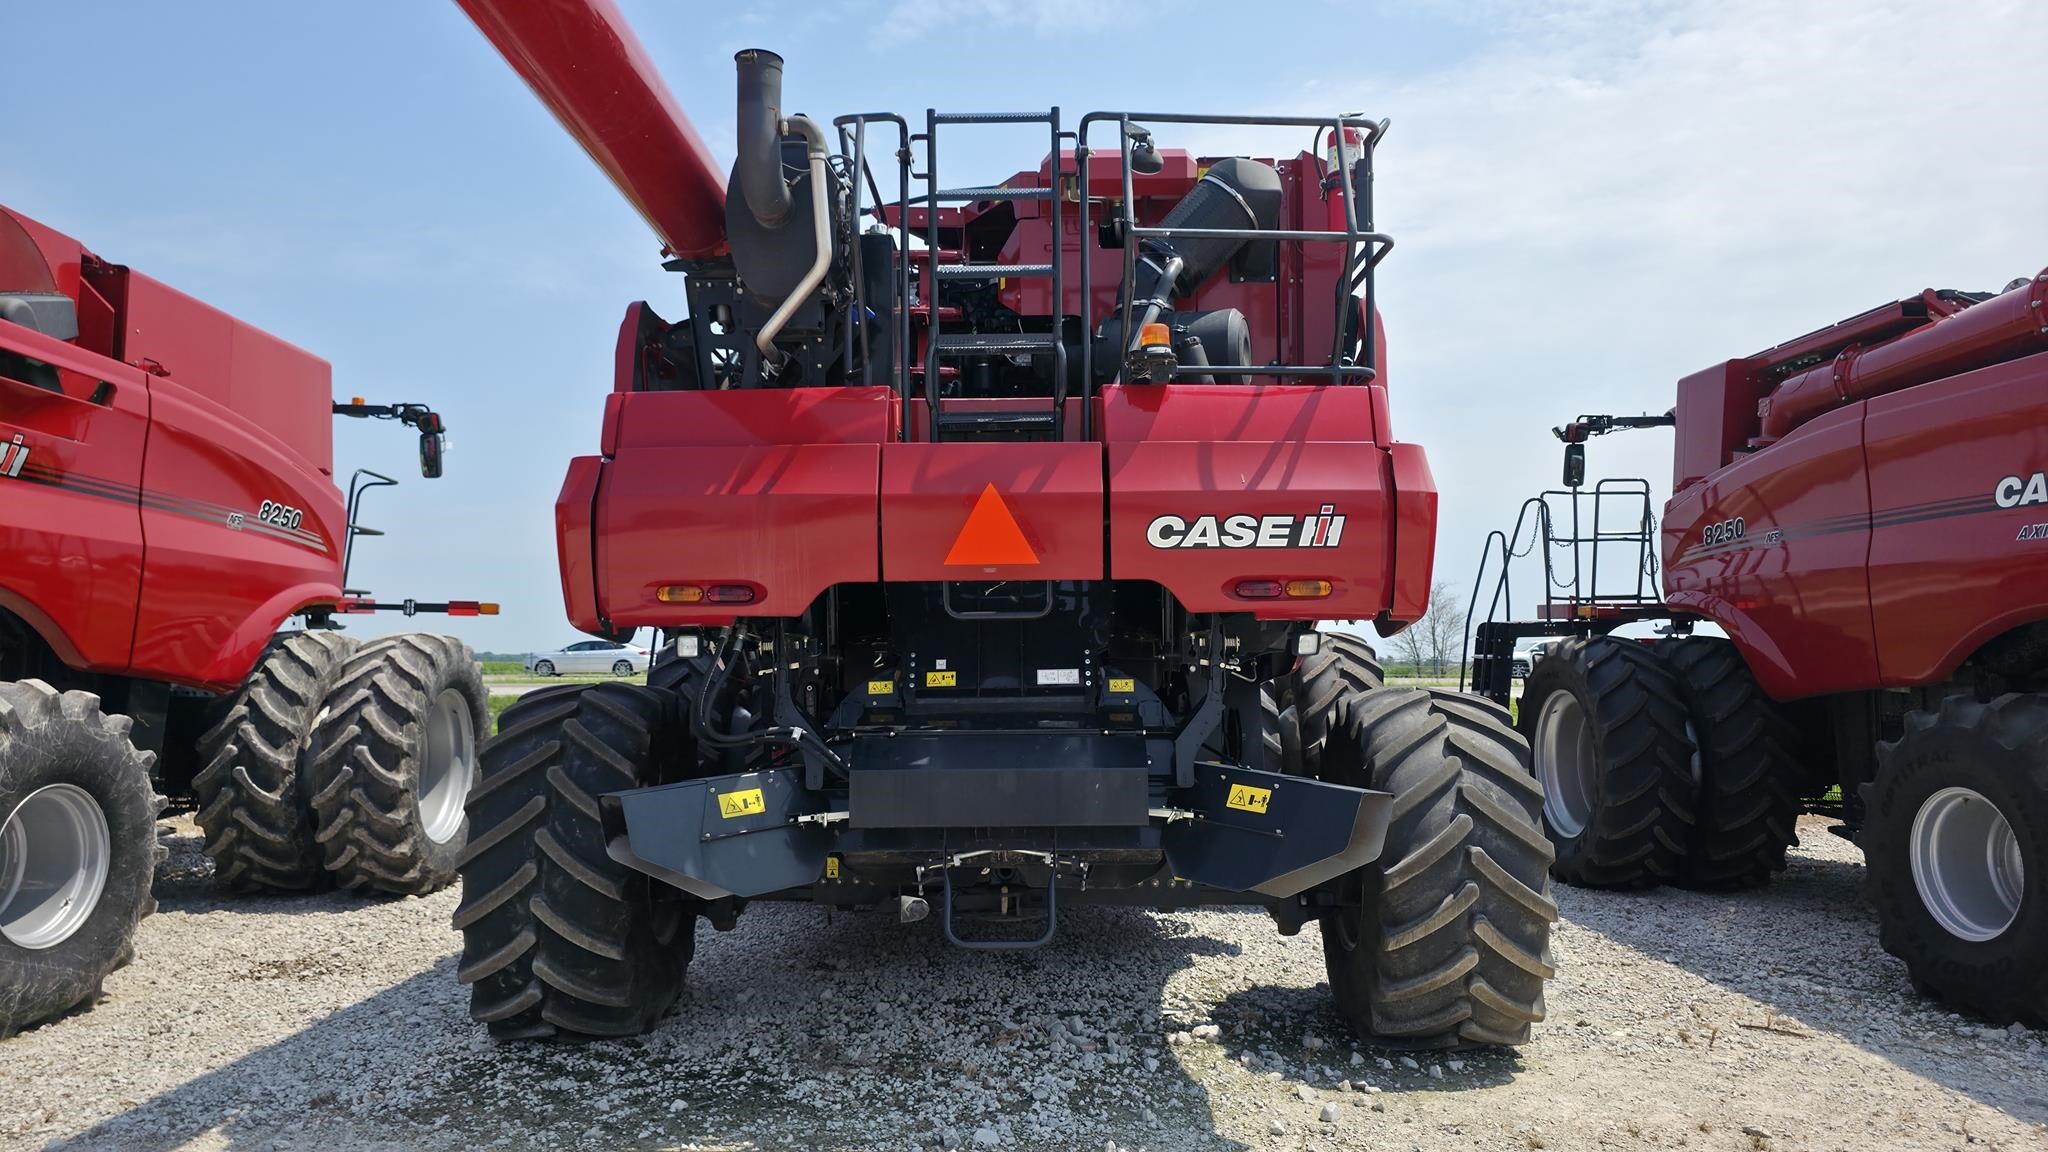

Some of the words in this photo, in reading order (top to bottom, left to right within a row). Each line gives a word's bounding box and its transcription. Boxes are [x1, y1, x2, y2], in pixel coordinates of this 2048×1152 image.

[258, 499, 303, 531] 8250
[1146, 514, 1295, 549] CASE
[1703, 516, 1745, 547] 8250
